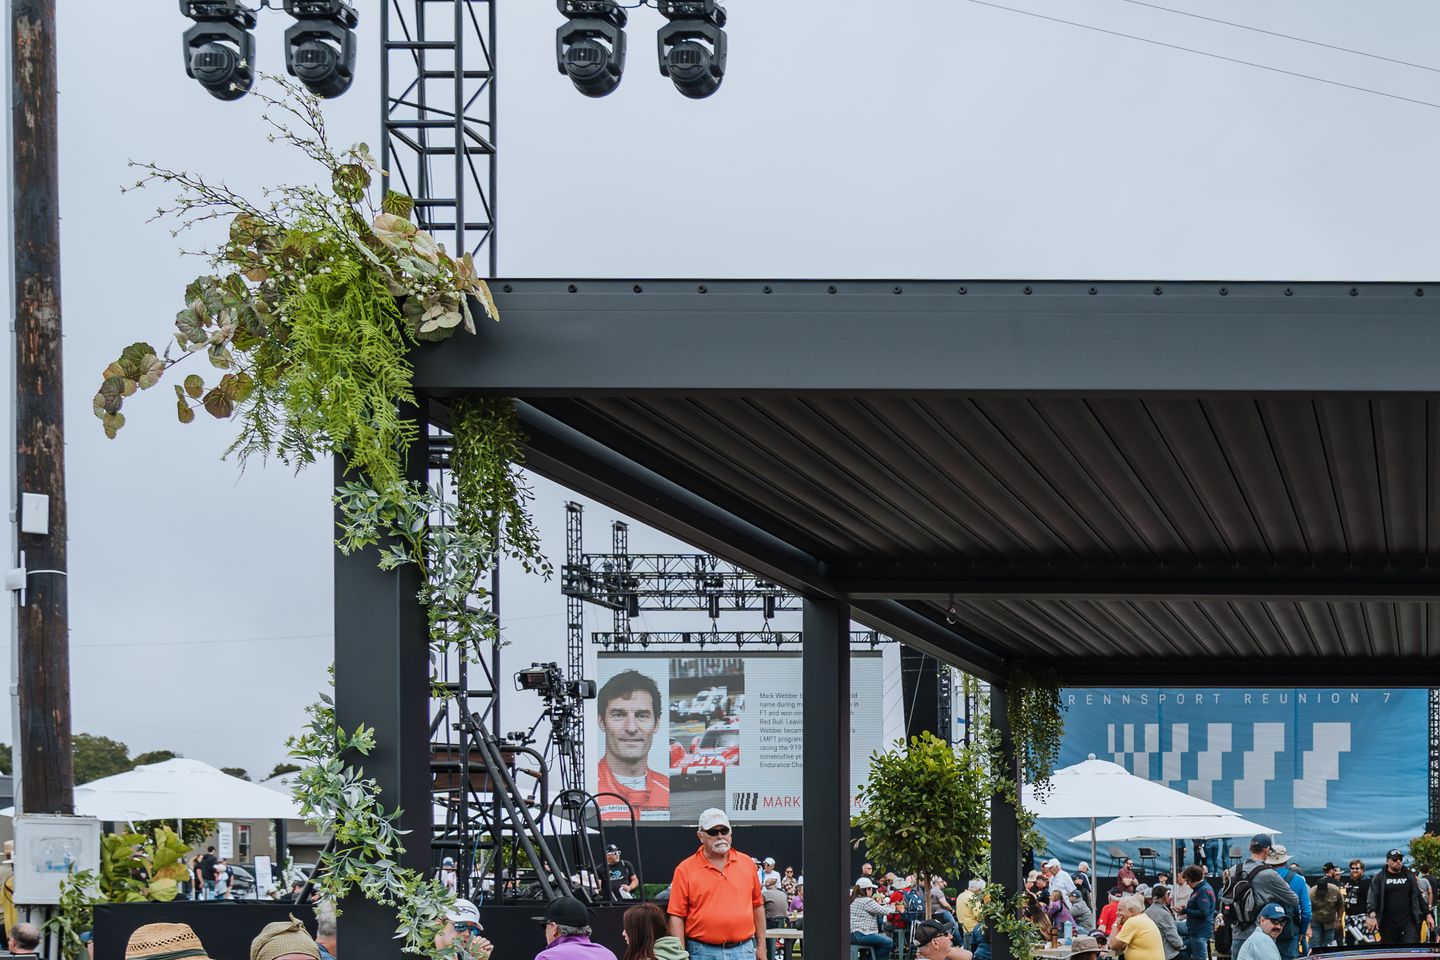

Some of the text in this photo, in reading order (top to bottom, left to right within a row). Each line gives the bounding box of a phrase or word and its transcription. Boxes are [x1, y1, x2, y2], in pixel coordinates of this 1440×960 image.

[1068, 692, 1391, 705] RENNSPORT REUNION 7
[762, 796, 801, 807] MARK
